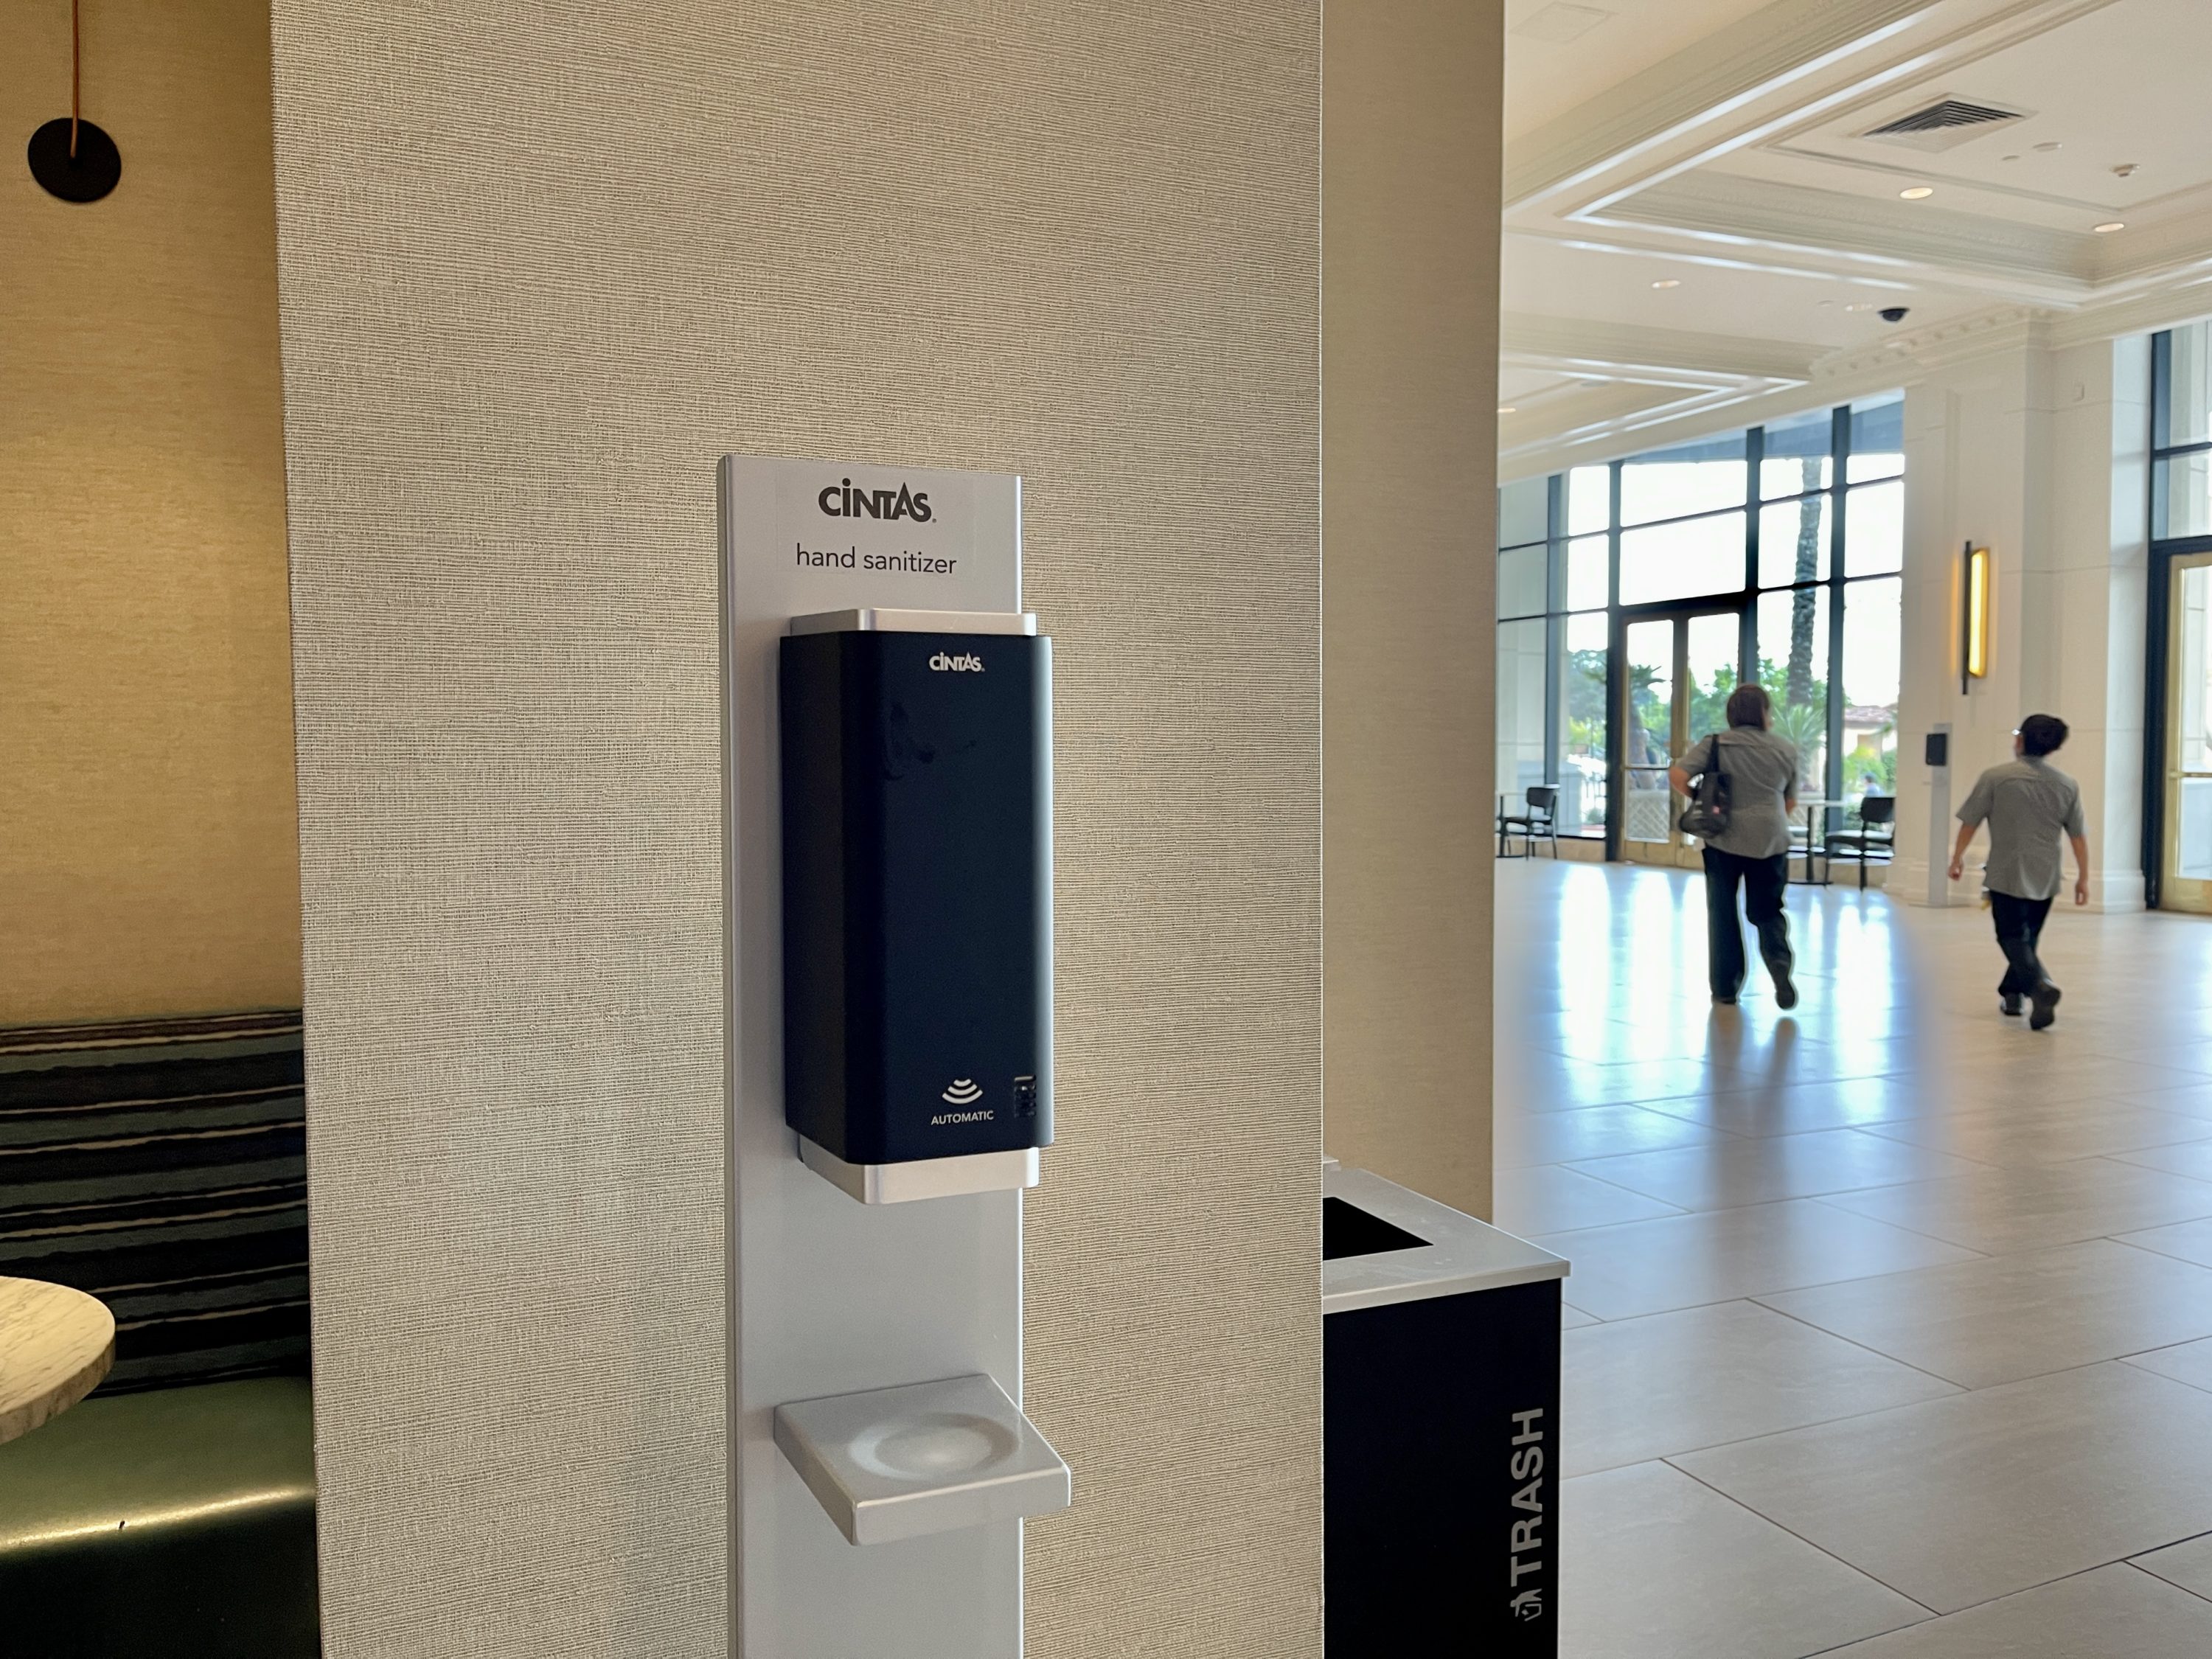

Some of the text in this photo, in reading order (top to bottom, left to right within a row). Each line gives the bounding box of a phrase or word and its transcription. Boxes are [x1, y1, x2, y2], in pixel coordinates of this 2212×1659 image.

[796, 542, 958, 574] hand sanitizer
[931, 1110, 995, 1126] AUTOMATIC
[1510, 1408, 1544, 1587] TRASH
